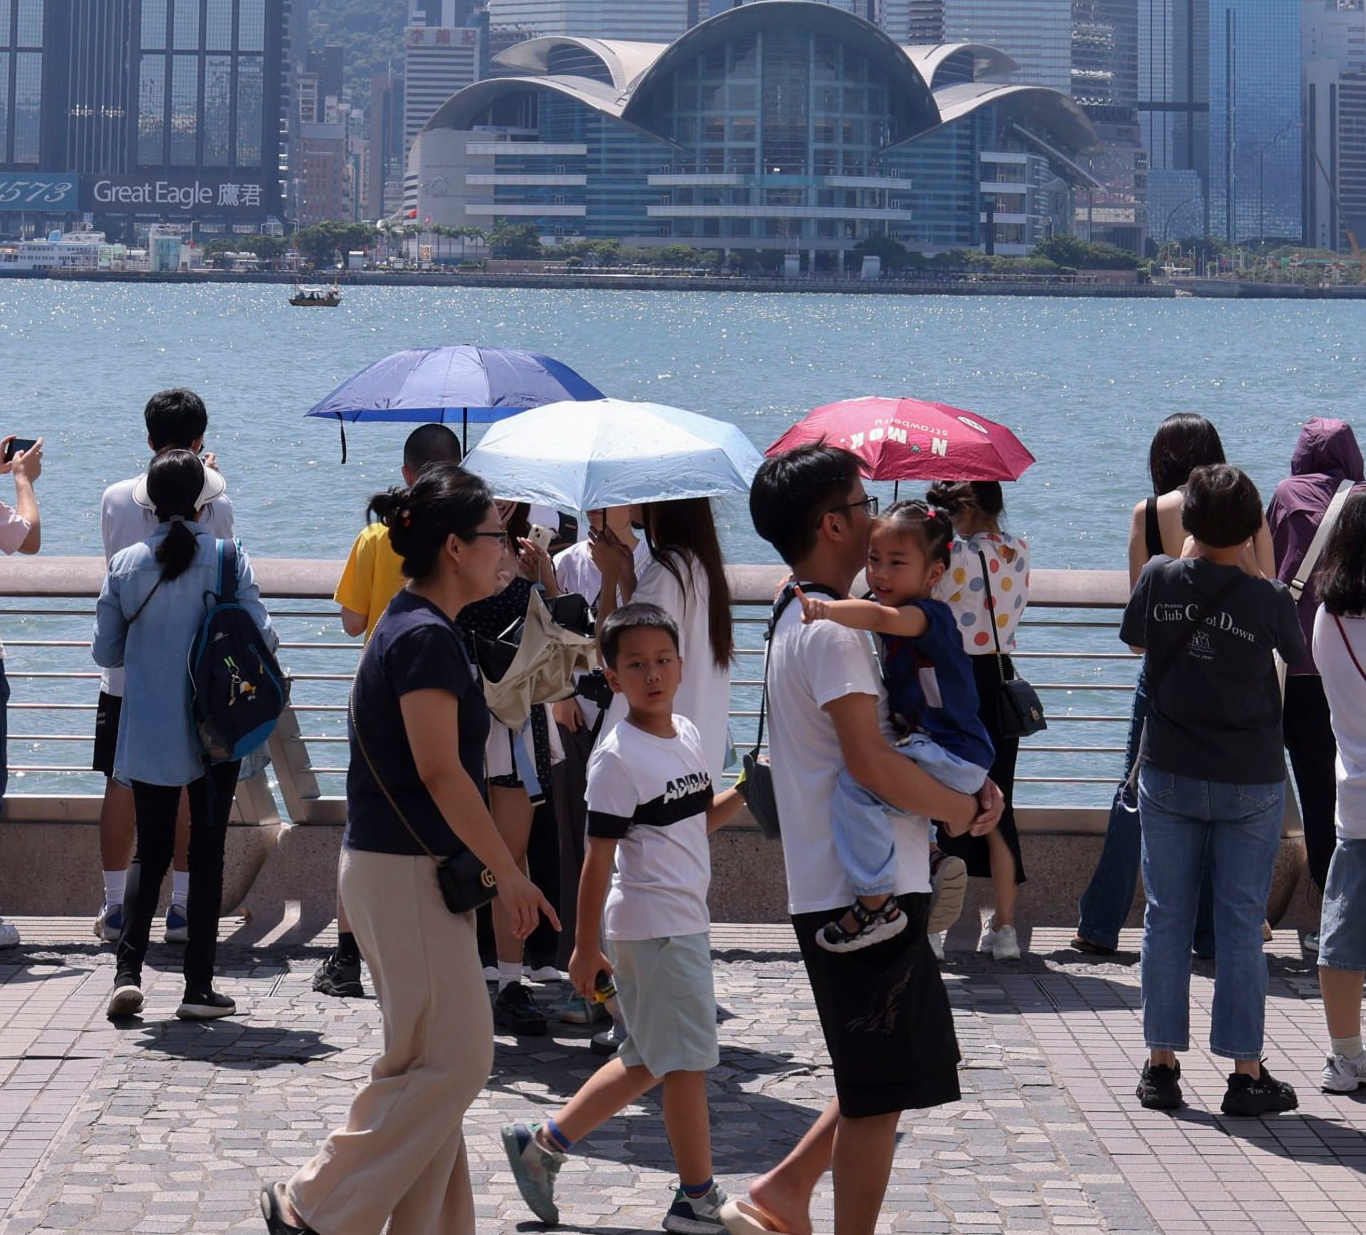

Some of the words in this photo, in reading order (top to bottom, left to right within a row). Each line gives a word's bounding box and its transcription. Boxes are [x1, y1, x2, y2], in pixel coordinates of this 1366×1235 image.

[93, 180, 153, 204] Great
[155, 180, 213, 210] Eagle
[217, 182, 264, 207] 鷹君
[1153, 603, 1183, 622] Club
[1184, 603, 1217, 628] Col
[1218, 612, 1256, 643] Down
